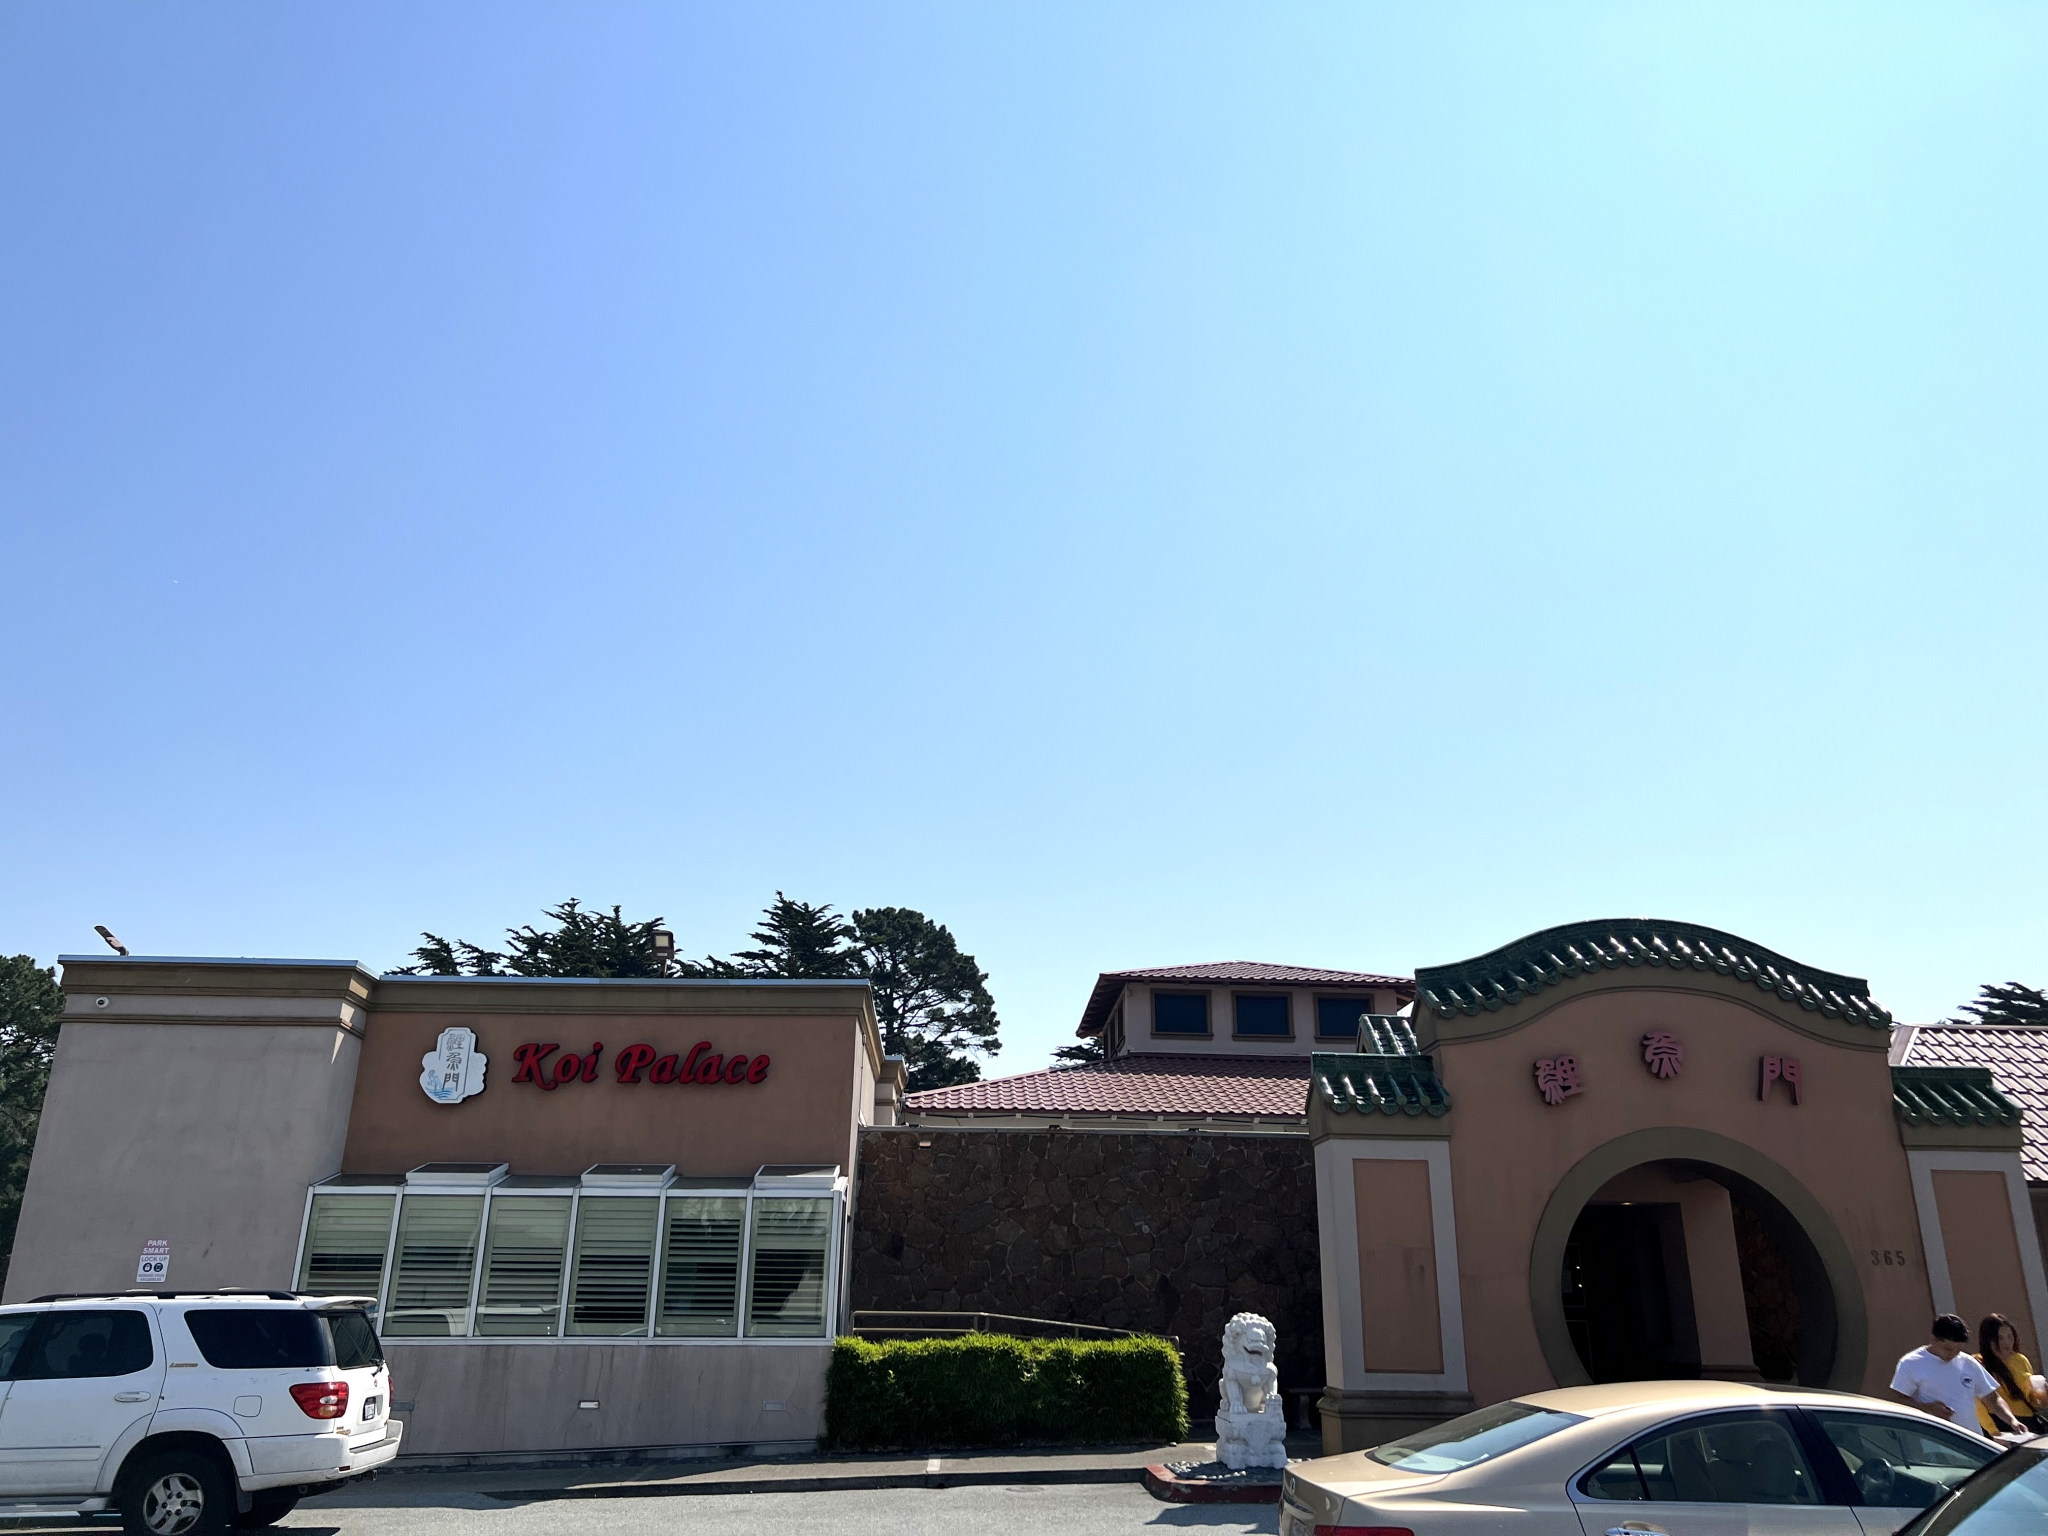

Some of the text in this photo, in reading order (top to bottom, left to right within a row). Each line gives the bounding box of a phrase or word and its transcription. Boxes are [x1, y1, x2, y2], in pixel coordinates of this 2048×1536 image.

[511, 1041, 771, 1091] Koi Palace
[1870, 1249, 1906, 1267] 365
